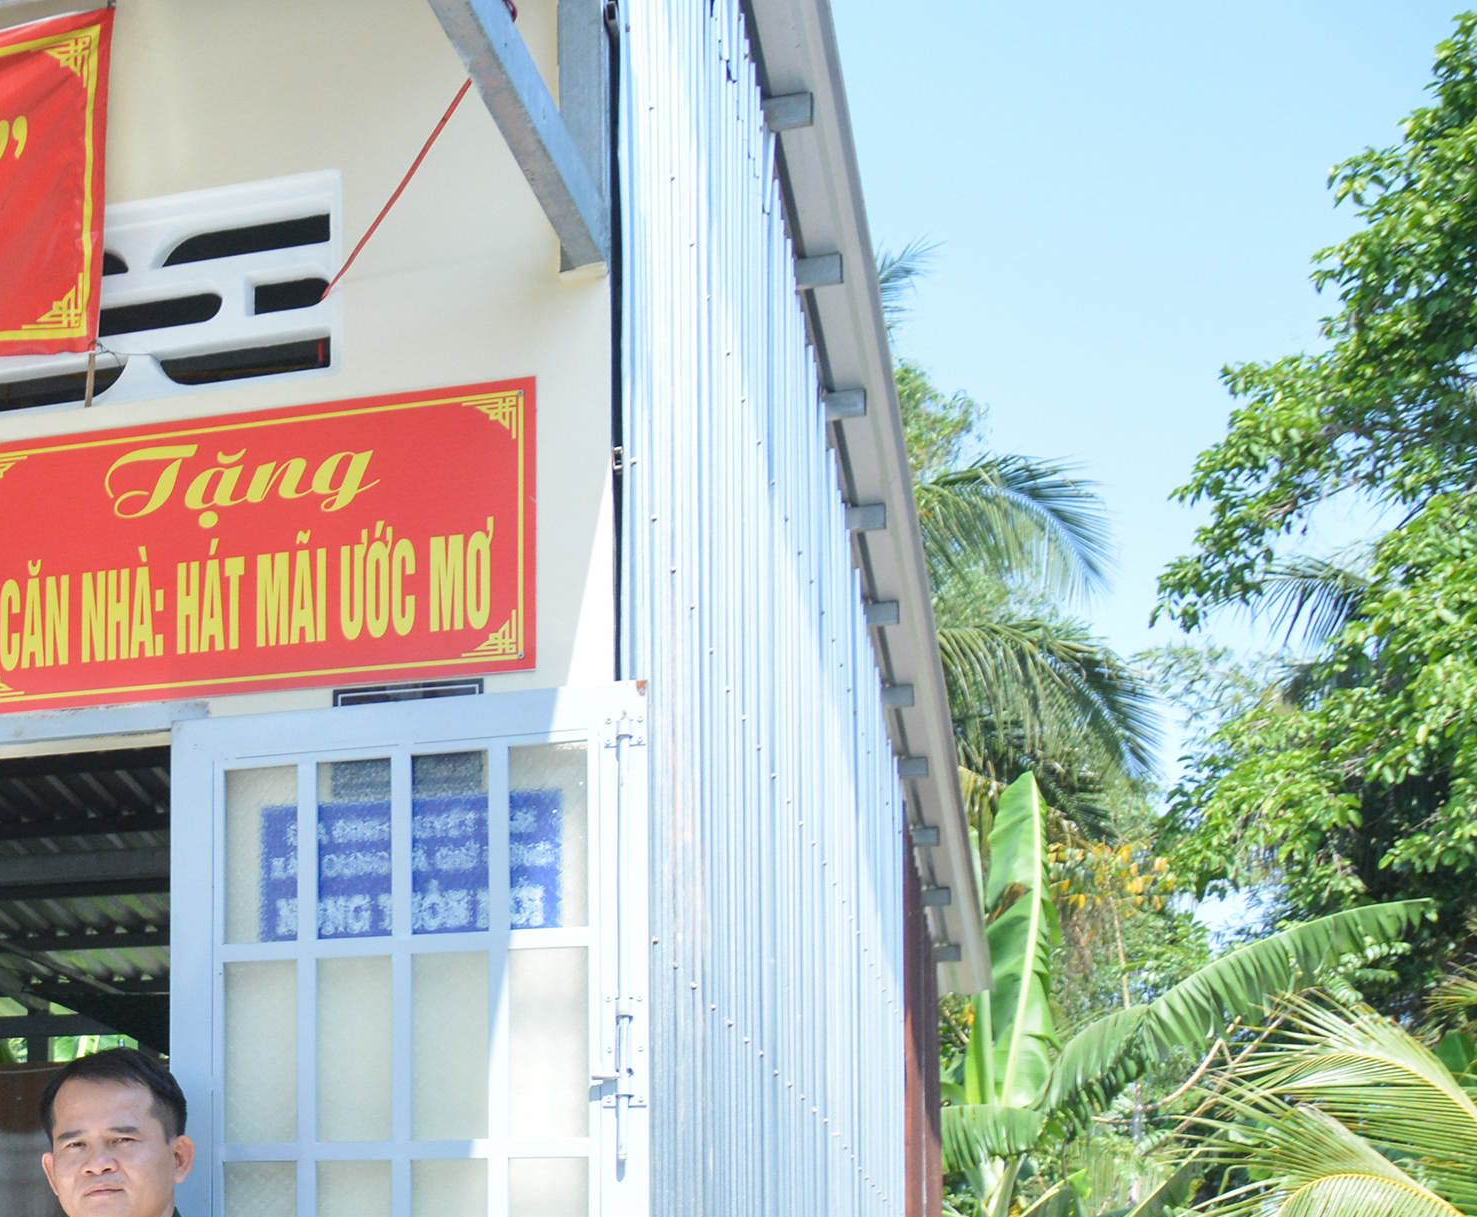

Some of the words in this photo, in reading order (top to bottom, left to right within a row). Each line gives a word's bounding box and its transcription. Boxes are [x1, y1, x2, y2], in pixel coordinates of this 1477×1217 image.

[105, 444, 380, 528] Tặng
[0, 559, 70, 671] CĂN
[82, 546, 165, 663] NHÀ:
[177, 538, 245, 654] HÁT
[257, 530, 328, 647] MÃI
[340, 520, 417, 640] ƯỚC
[430, 516, 495, 632] MƠ
